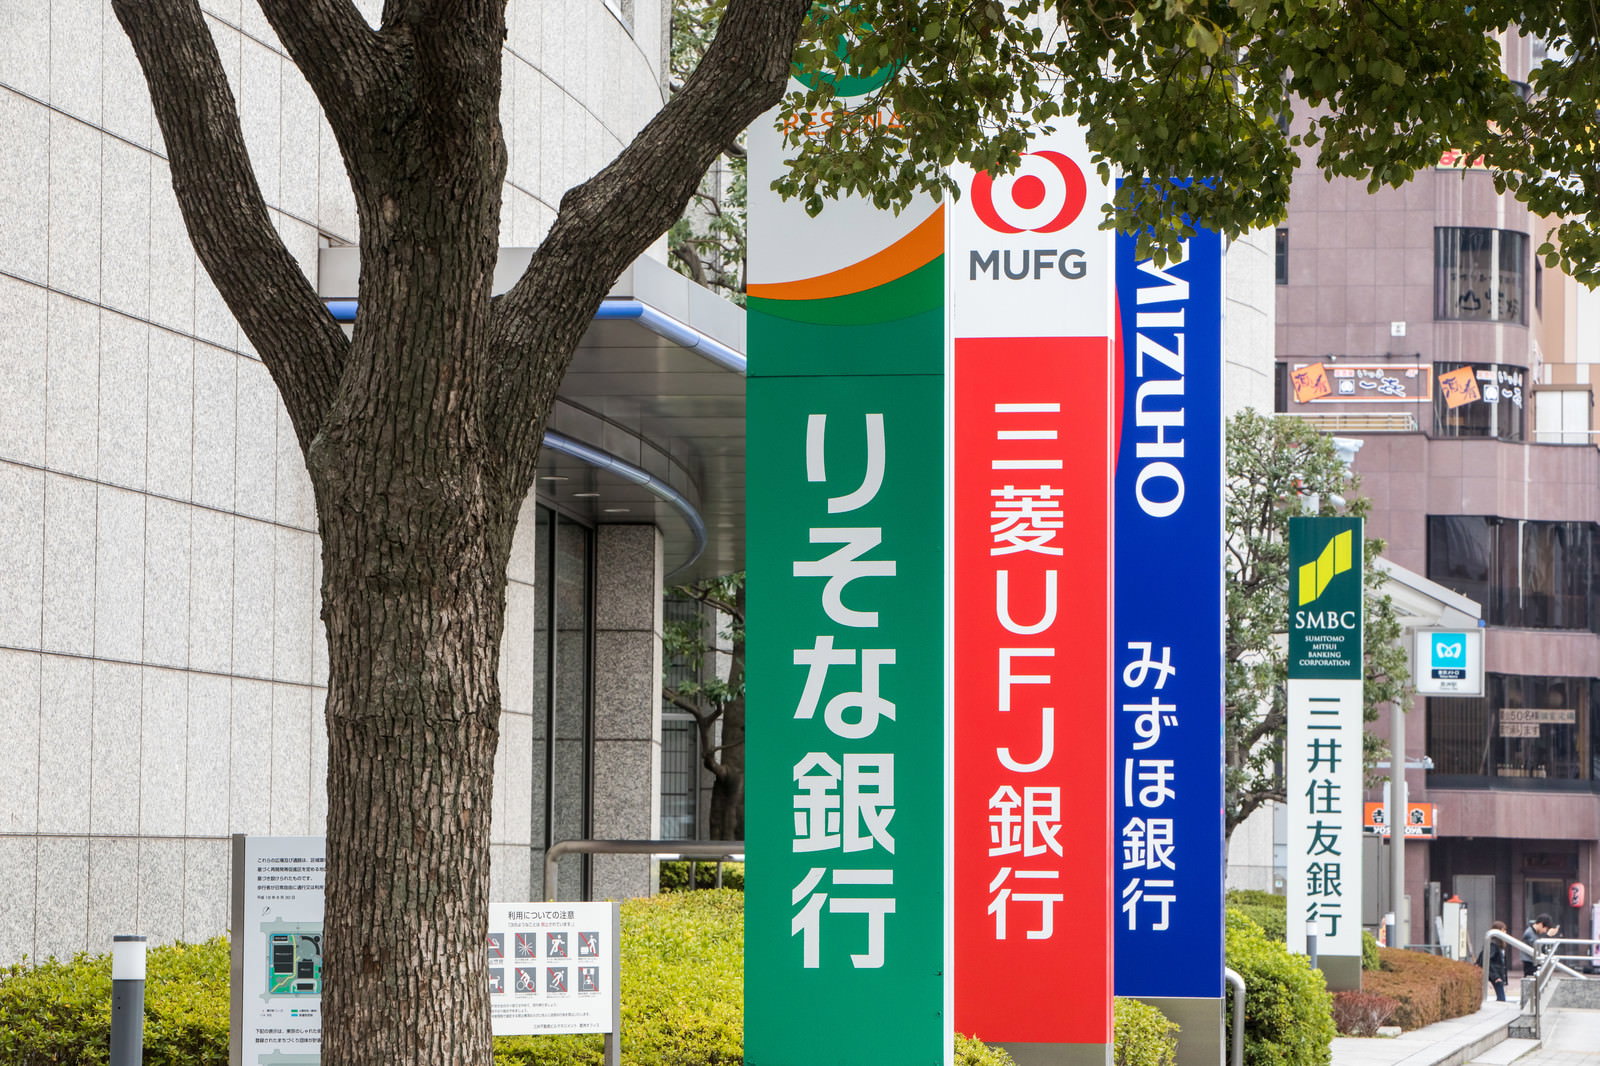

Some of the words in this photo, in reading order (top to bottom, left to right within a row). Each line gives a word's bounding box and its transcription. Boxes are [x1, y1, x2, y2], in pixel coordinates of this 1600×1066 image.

[970, 249, 1086, 281] MUFG
[1135, 238, 1190, 518] MIZUHO
[988, 402, 1064, 940] 三菱UFJ銀行
[1295, 610, 1356, 629] SMBC
[791, 413, 897, 969] りそな銀行
[1122, 641, 1179, 931] みずほ銀行
[1305, 697, 1342, 937] 三井住友銀行
[1372, 808, 1424, 824] 吉家
[1373, 826, 1423, 835] YOSOYA
[508, 910, 575, 920] 利用についての注意
